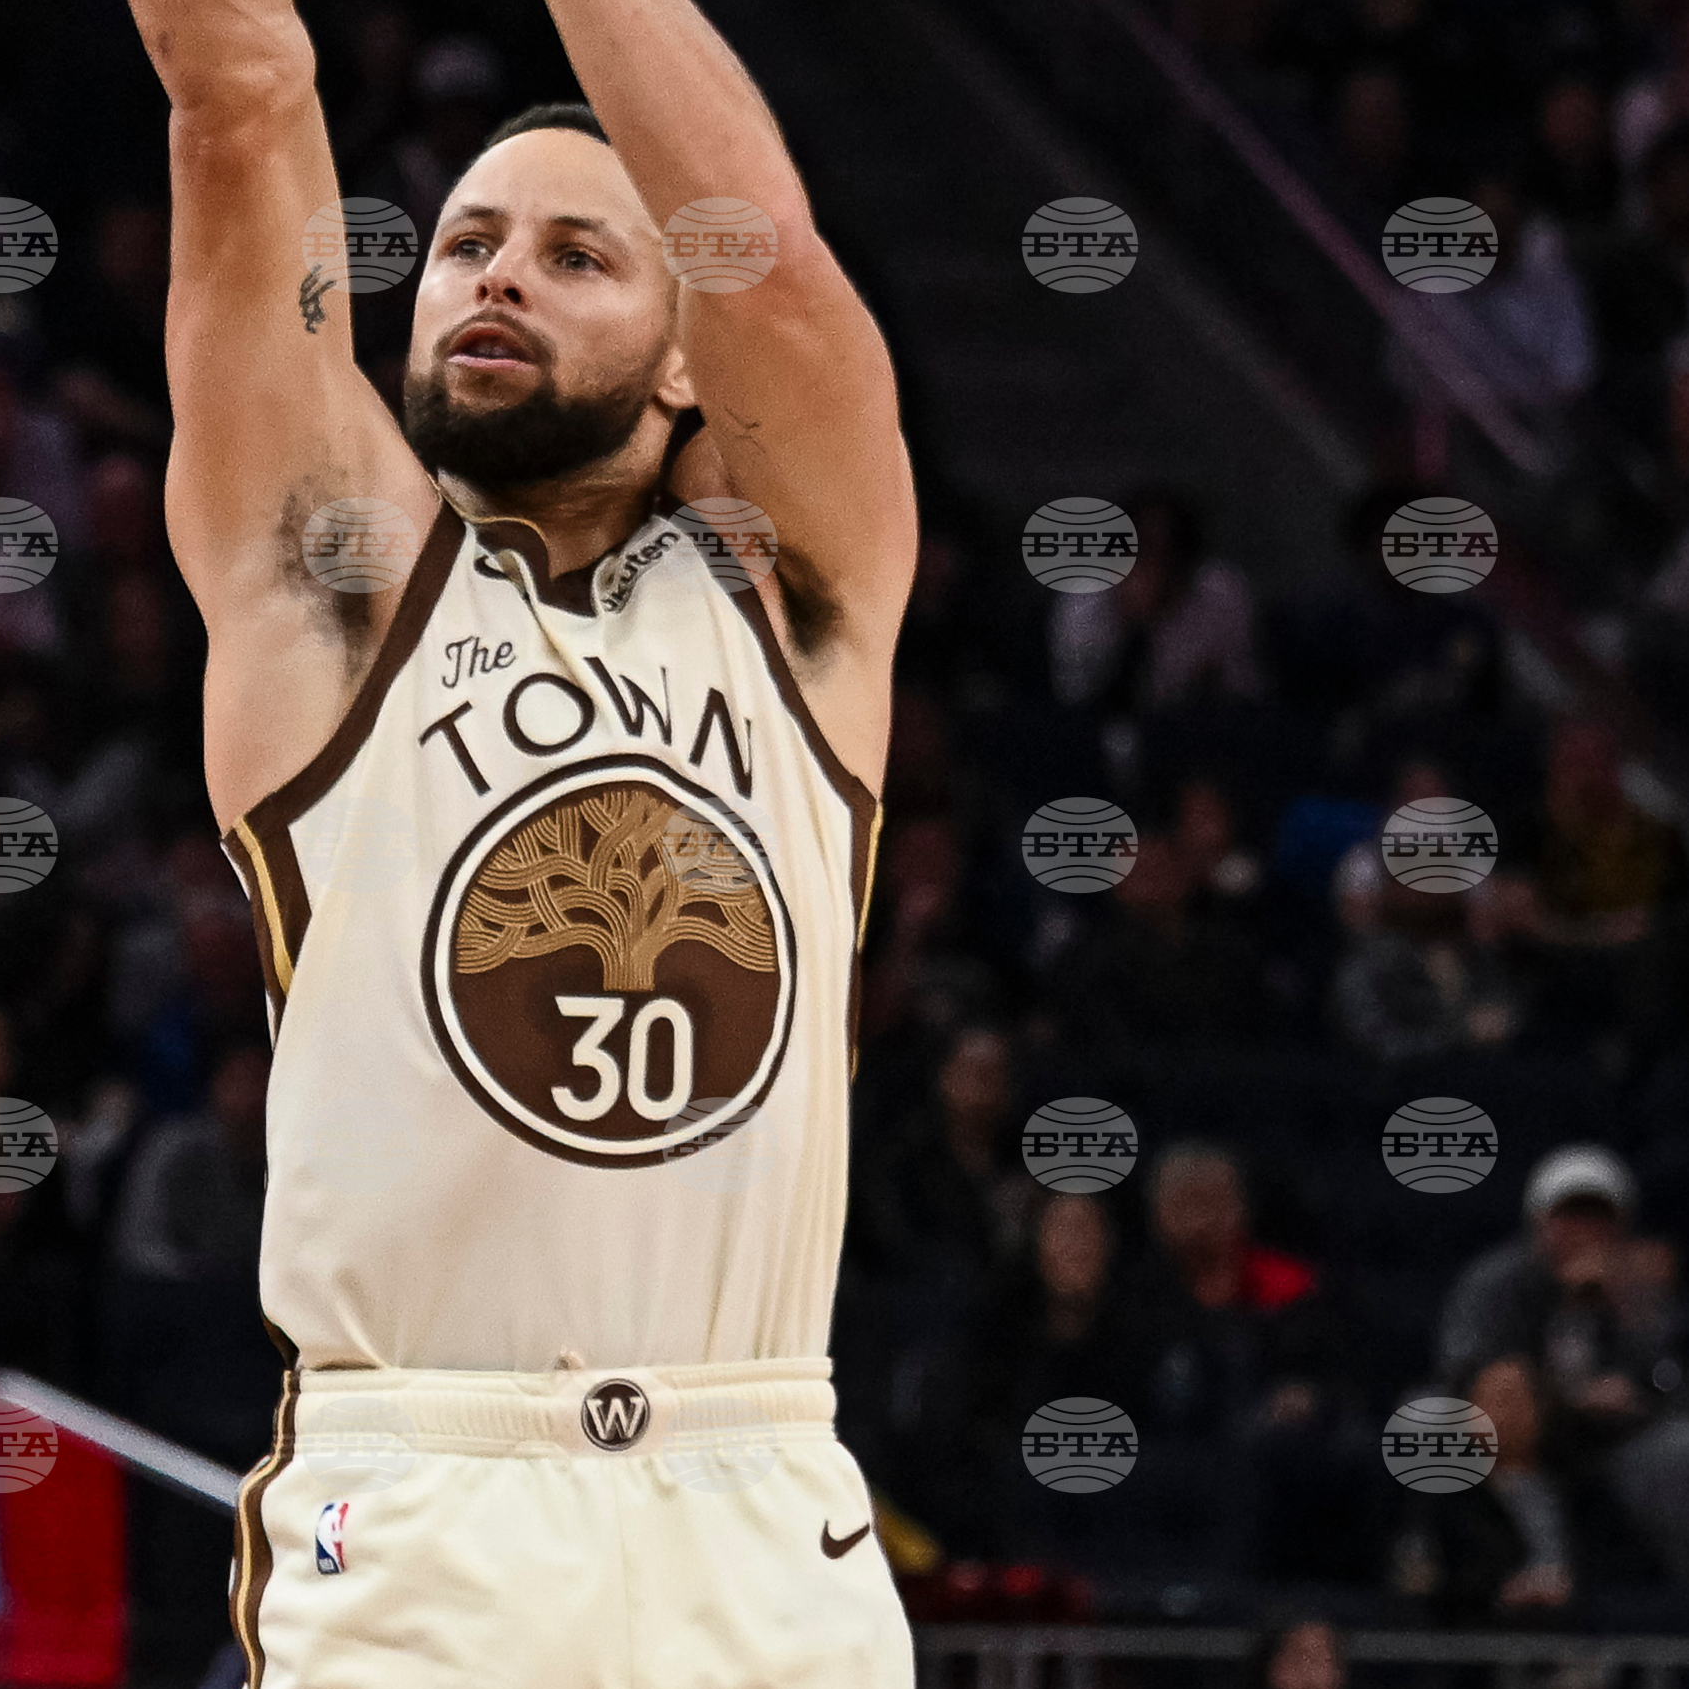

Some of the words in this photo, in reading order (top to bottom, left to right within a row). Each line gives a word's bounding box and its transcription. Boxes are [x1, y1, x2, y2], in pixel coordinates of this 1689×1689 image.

[442, 635, 516, 689] The
[418, 656, 752, 800] TOWN
[551, 995, 694, 1123] 30
[586, 1396, 644, 1440] W
